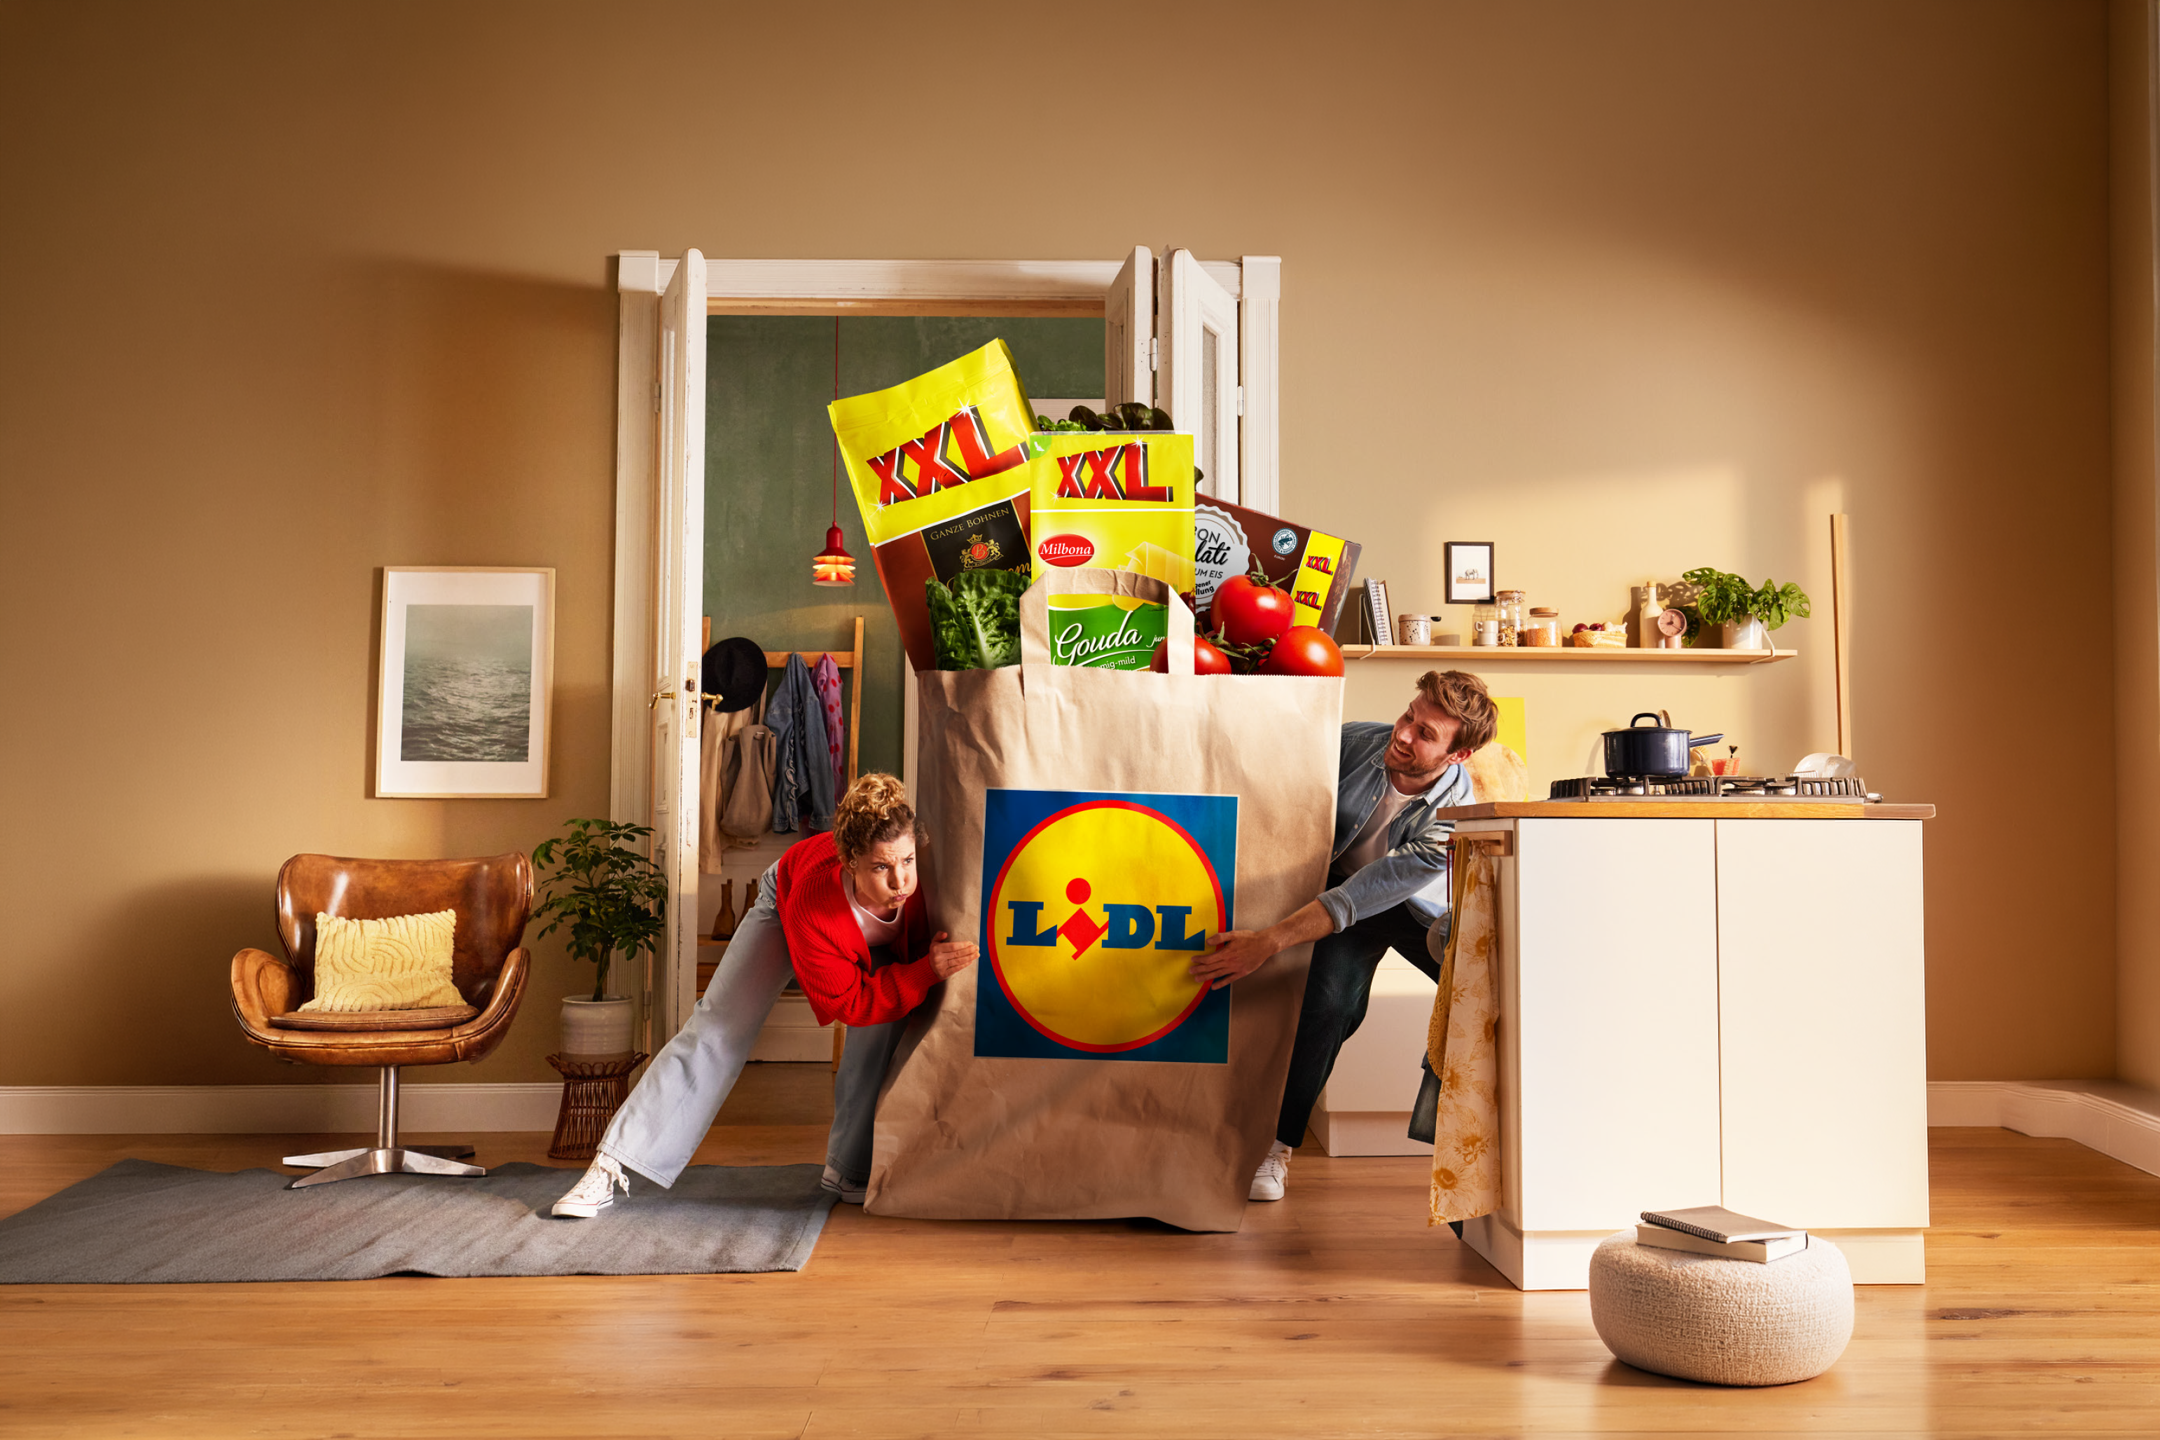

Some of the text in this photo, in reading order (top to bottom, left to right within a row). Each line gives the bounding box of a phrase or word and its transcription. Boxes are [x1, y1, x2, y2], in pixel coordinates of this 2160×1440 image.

[866, 404, 1031, 506] XXL
[1056, 441, 1174, 502] XXL
[930, 507, 1010, 541] GANZE BOHNEN
[1195, 525, 1221, 545] ON
[1040, 543, 1092, 555] Milbona
[1195, 539, 1231, 565] lati
[1195, 567, 1223, 579] UM EIS
[1305, 555, 1333, 576] XXL
[1195, 585, 1215, 595] llung
[1294, 591, 1322, 611] XXL
[1053, 610, 1166, 666] Gouda jun
[1100, 656, 1136, 669] mig-mild
